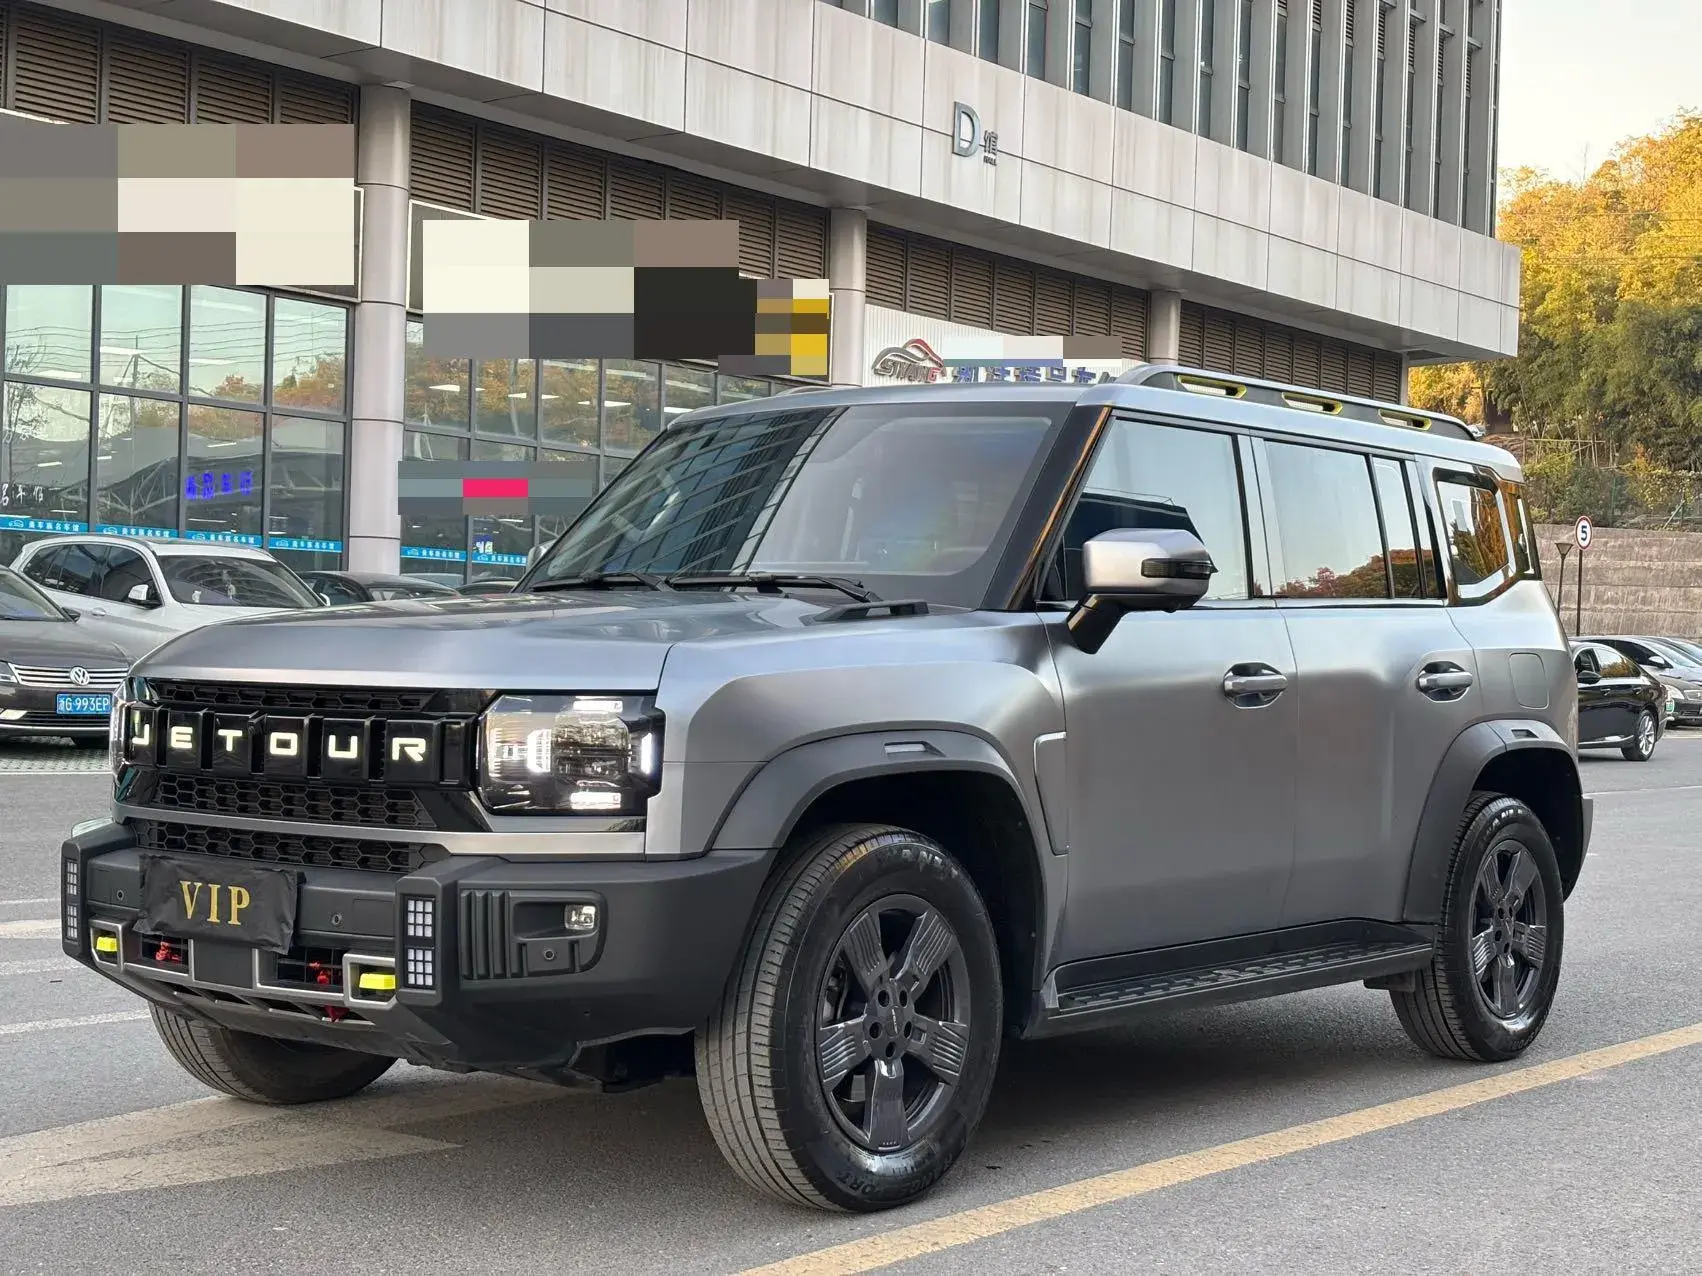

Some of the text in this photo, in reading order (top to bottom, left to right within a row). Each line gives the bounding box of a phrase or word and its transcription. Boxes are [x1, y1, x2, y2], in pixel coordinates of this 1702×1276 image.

[952, 101, 980, 157] D
[1581, 525, 1588, 541] 5
[132, 723, 426, 762] JETOUR
[179, 880, 250, 926] VIP
